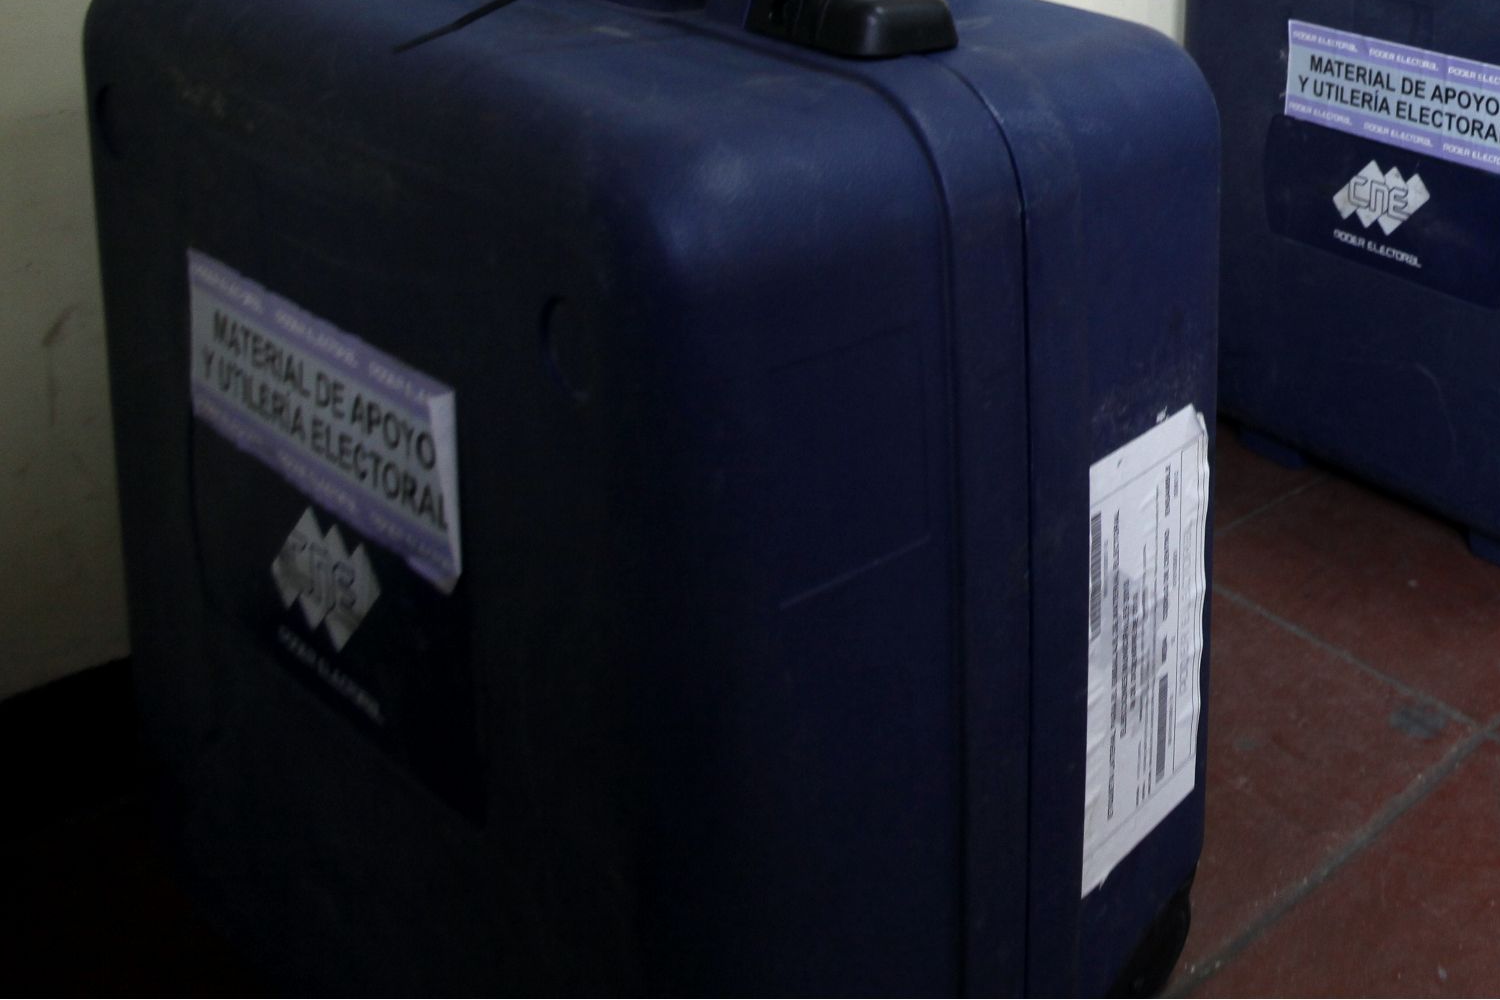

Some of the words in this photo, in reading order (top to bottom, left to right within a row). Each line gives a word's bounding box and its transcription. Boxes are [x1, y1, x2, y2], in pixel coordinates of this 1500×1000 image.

[1298, 74, 1309, 92] Y
[1312, 80, 1391, 116] UTILERÍA
[1309, 54, 1395, 92] MATERIAL
[1401, 76, 1426, 98] DE
[1431, 83, 1500, 116] APOYO
[1333, 228, 1366, 249] PODER
[212, 311, 310, 398] MATERIAL
[314, 372, 345, 418] DE
[350, 393, 436, 472] APOYO
[311, 419, 447, 530] ELECTORAL
